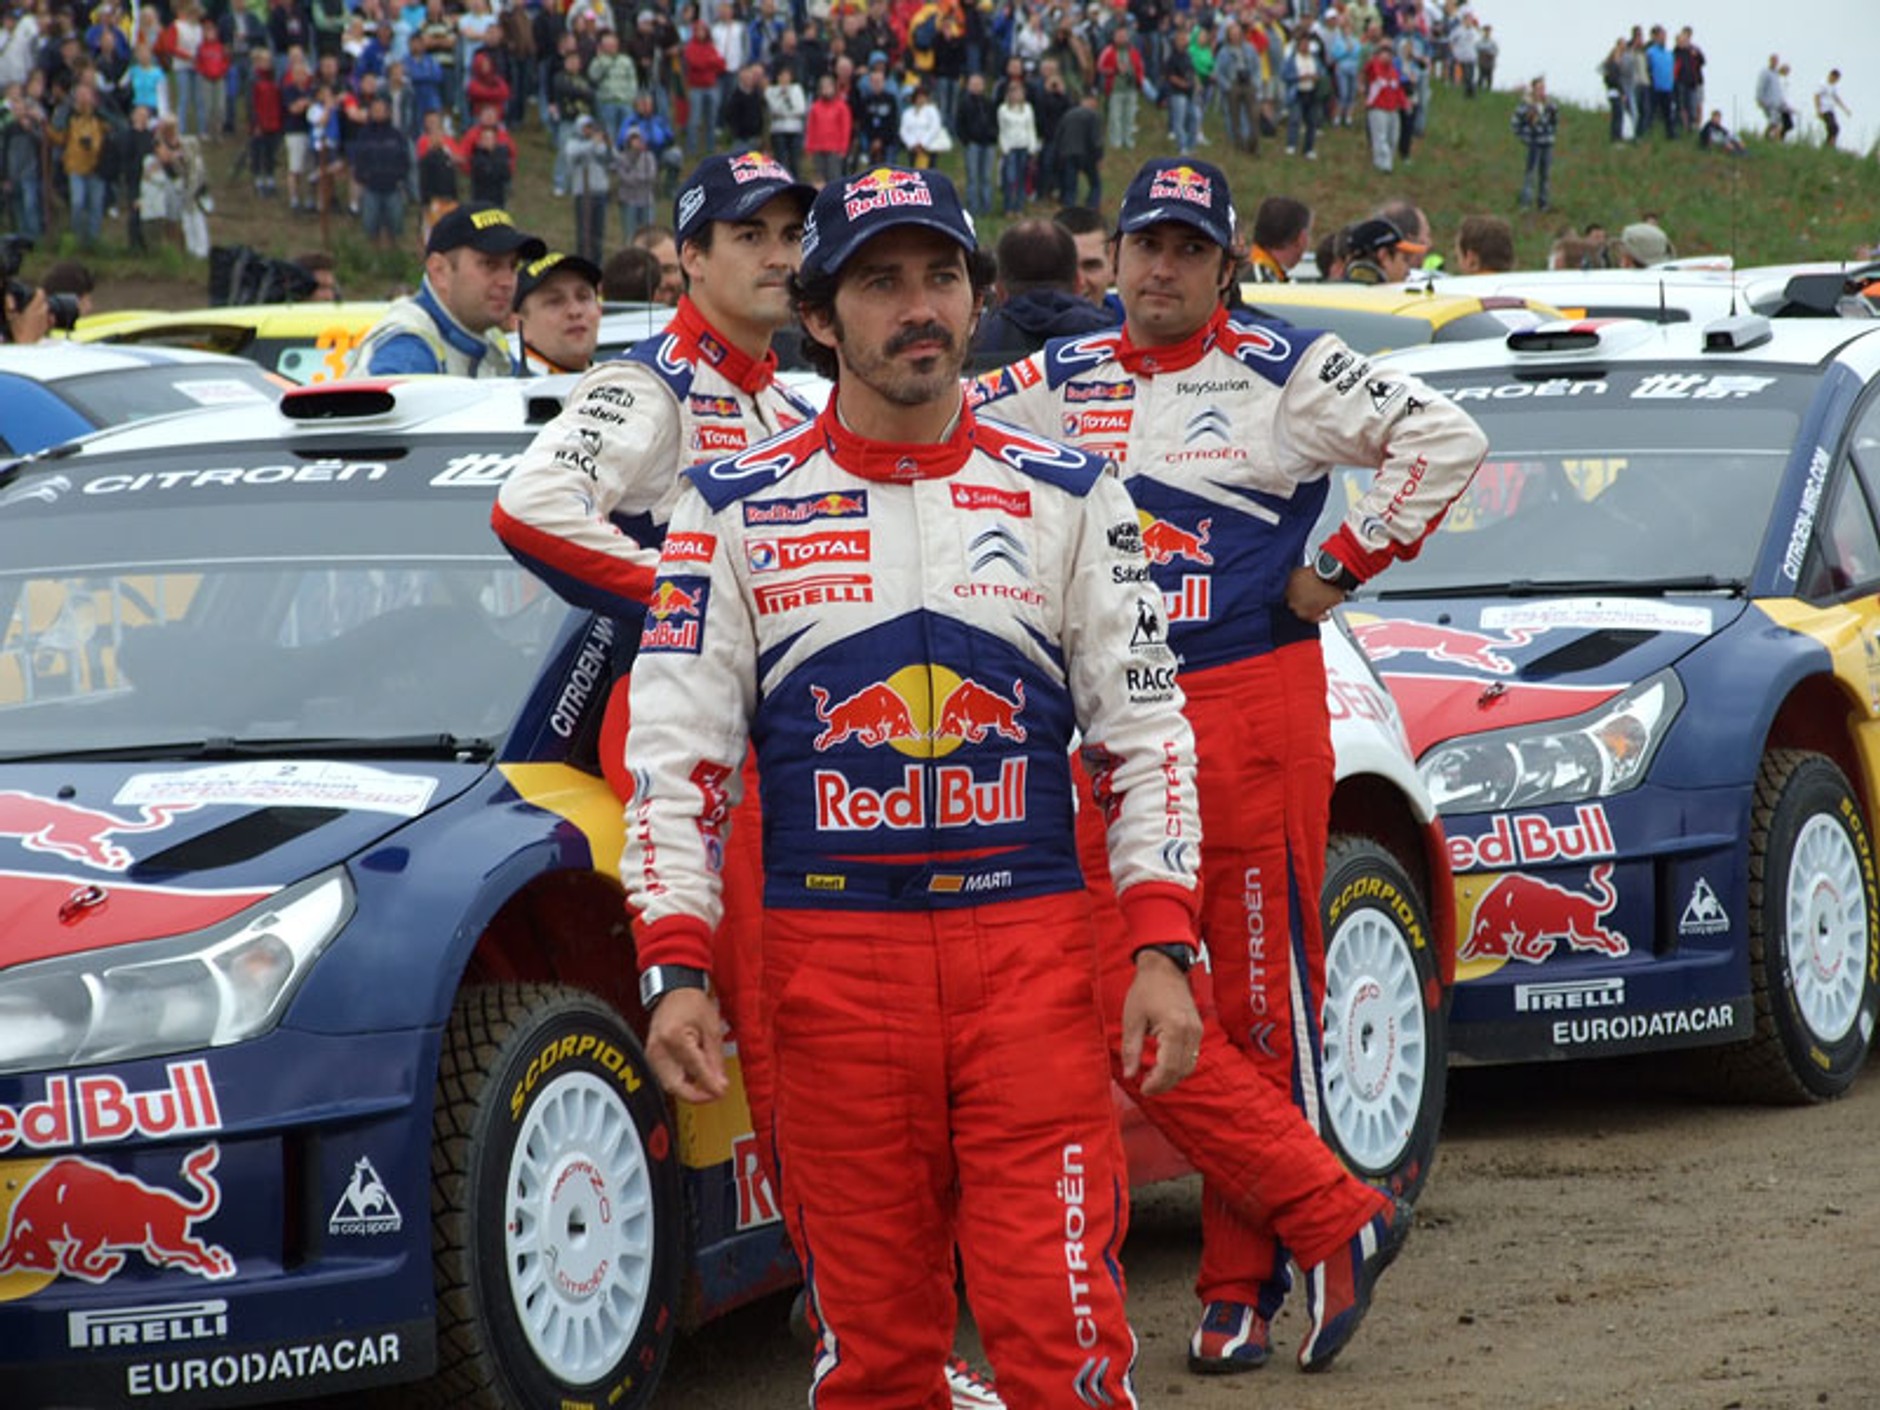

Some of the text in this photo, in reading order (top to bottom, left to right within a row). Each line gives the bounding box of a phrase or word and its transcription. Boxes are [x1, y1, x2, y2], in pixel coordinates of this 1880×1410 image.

[845, 187, 932, 222] Red Bull
[1176, 380, 1250, 396] PlayStation
[973, 491, 1027, 512] Santander
[781, 539, 866, 563] TOTAL
[752, 573, 874, 616] PIRELLI
[1161, 574, 1211, 621] ull
[814, 764, 926, 831] Red
[934, 755, 1029, 829] Bull
[1445, 803, 1617, 869] ed Bull
[1329, 876, 1426, 951] SCORPION
[1242, 867, 1267, 1016] CITROËN
[1514, 977, 1625, 1012] PIRELLI
[1553, 1004, 1734, 1045] EURODATACAR
[511, 1033, 642, 1122] SCORPION
[0, 1059, 222, 1151] ed Bull
[1056, 1143, 1098, 1349] CITROËN
[69, 1300, 228, 1348] PIRELLI
[127, 1333, 400, 1396] EURODATACAR
